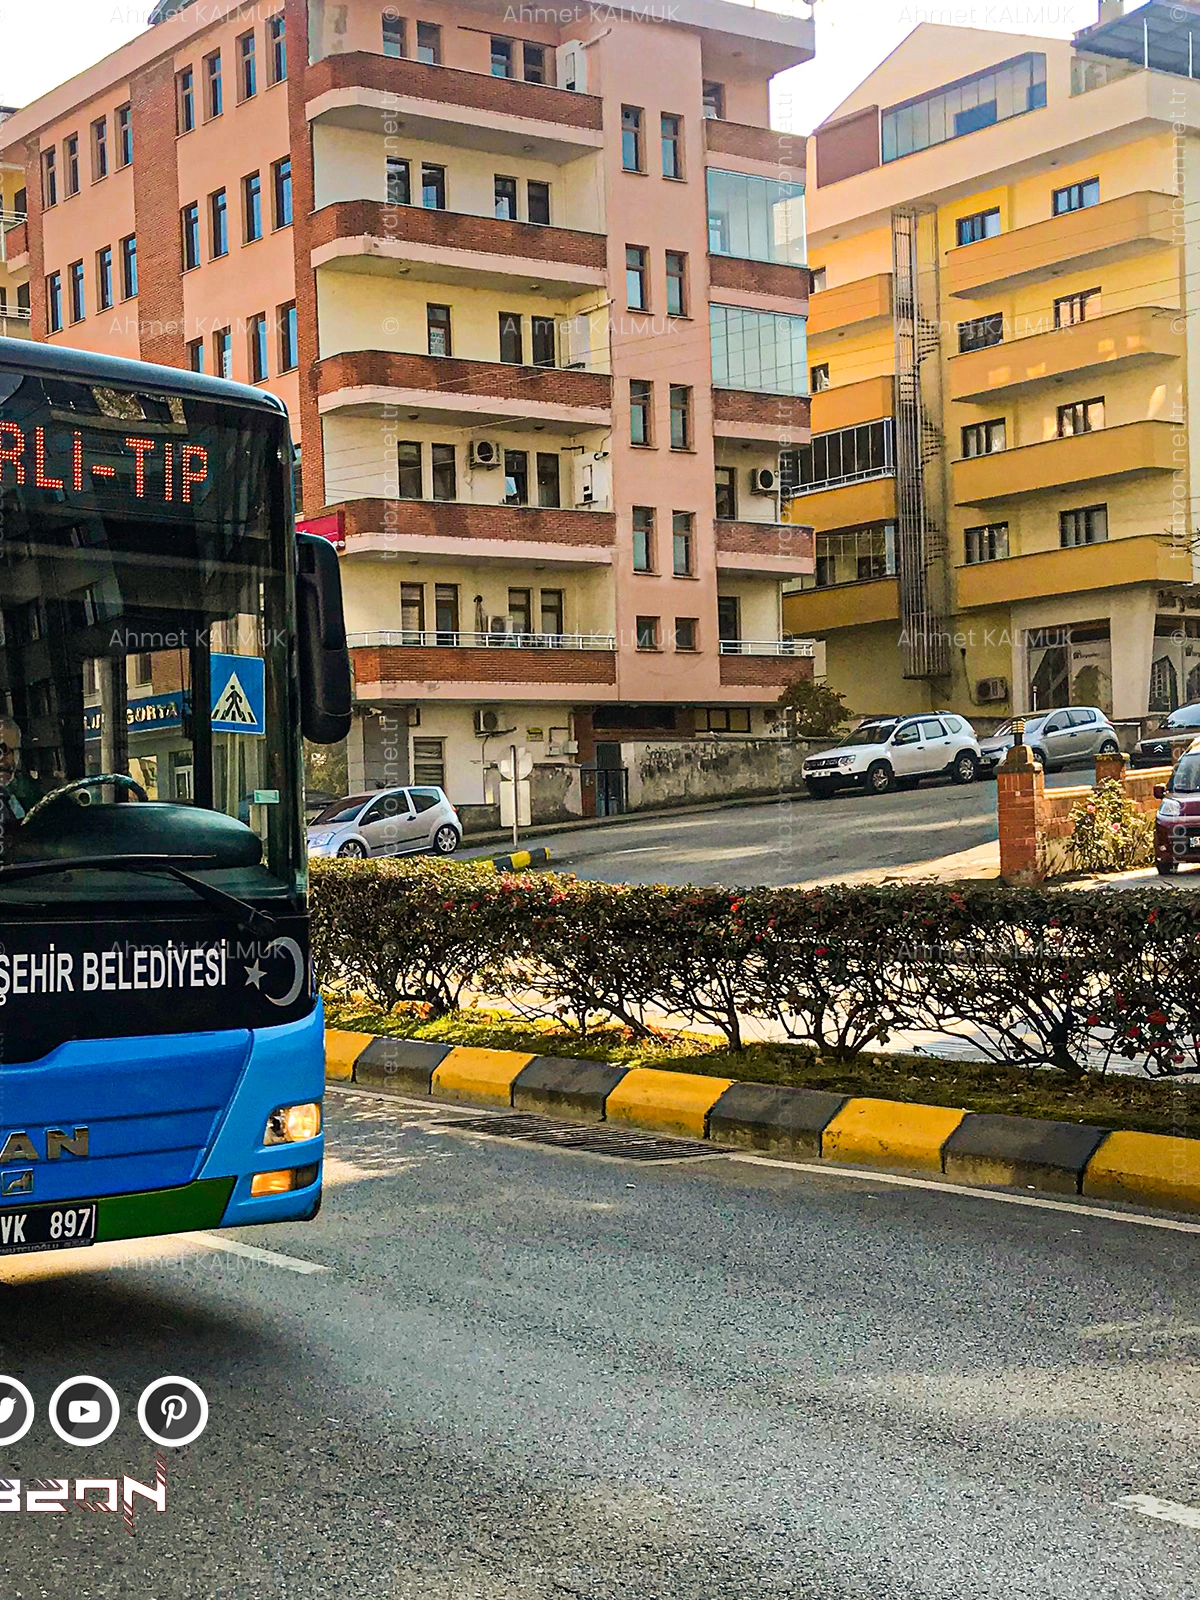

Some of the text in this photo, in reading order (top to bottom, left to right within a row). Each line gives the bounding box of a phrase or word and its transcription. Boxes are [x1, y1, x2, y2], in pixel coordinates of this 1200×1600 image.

[126, 701, 178, 725] GORTA
[83, 938, 227, 992] BELEDİYESİ
[1, 1214, 28, 1244] VK
[50, 1208, 91, 1239] 897
